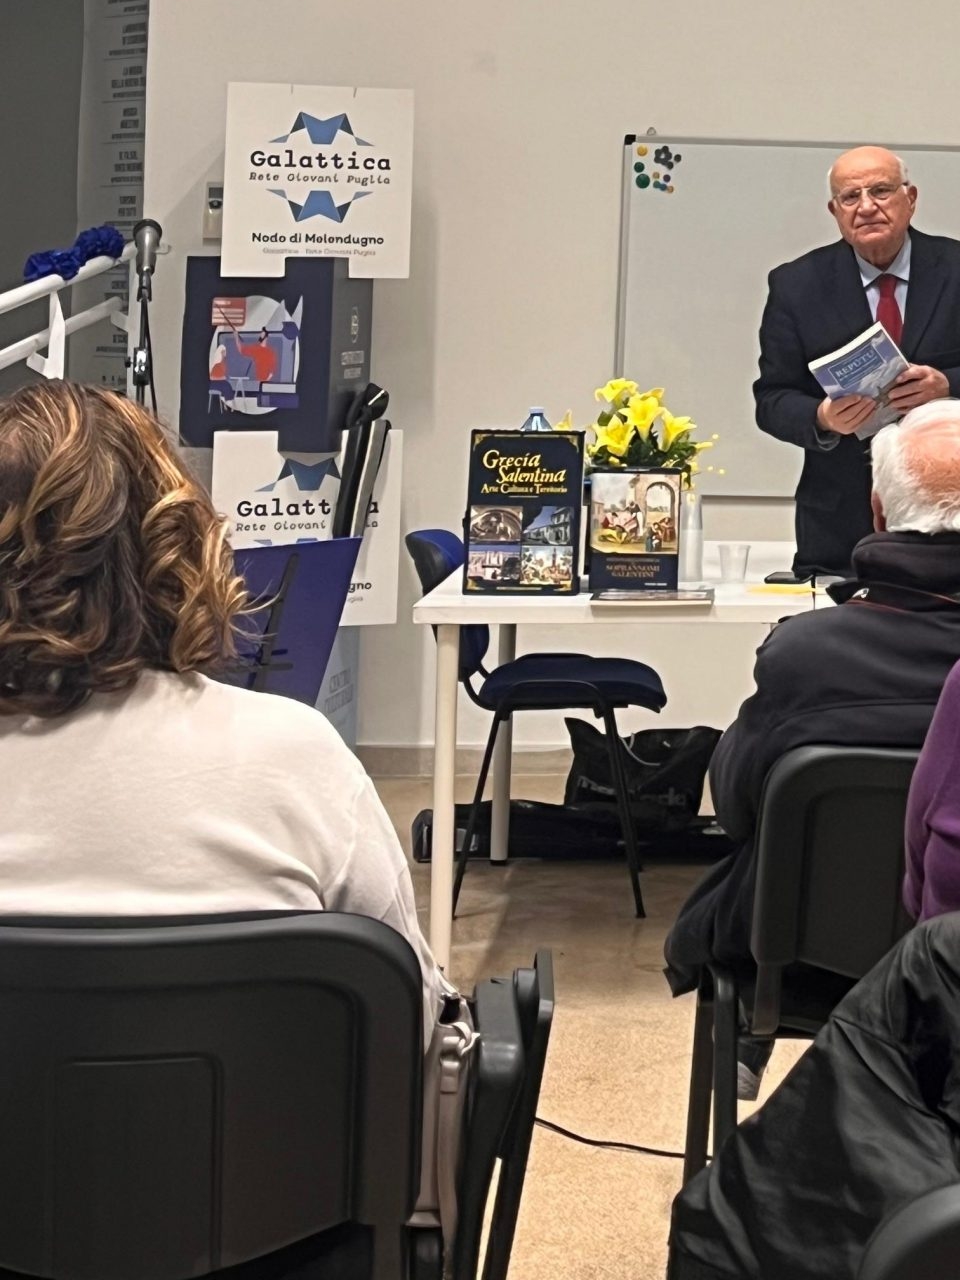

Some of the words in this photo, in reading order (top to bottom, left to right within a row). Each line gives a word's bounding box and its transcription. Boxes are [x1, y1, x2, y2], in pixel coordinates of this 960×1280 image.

[250, 150, 391, 170] Galattica
[249, 172, 279, 181] Rete
[347, 175, 391, 186] Puglia
[252, 232, 286, 243] Nodo
[289, 232, 302, 243] di
[305, 233, 385, 246] Melendugno
[482, 449, 542, 469] Grecia
[495, 465, 567, 484] Salentina
[480, 483, 499, 494] Arte
[237, 498, 379, 517] Galatta
[236, 522, 267, 532] Rete
